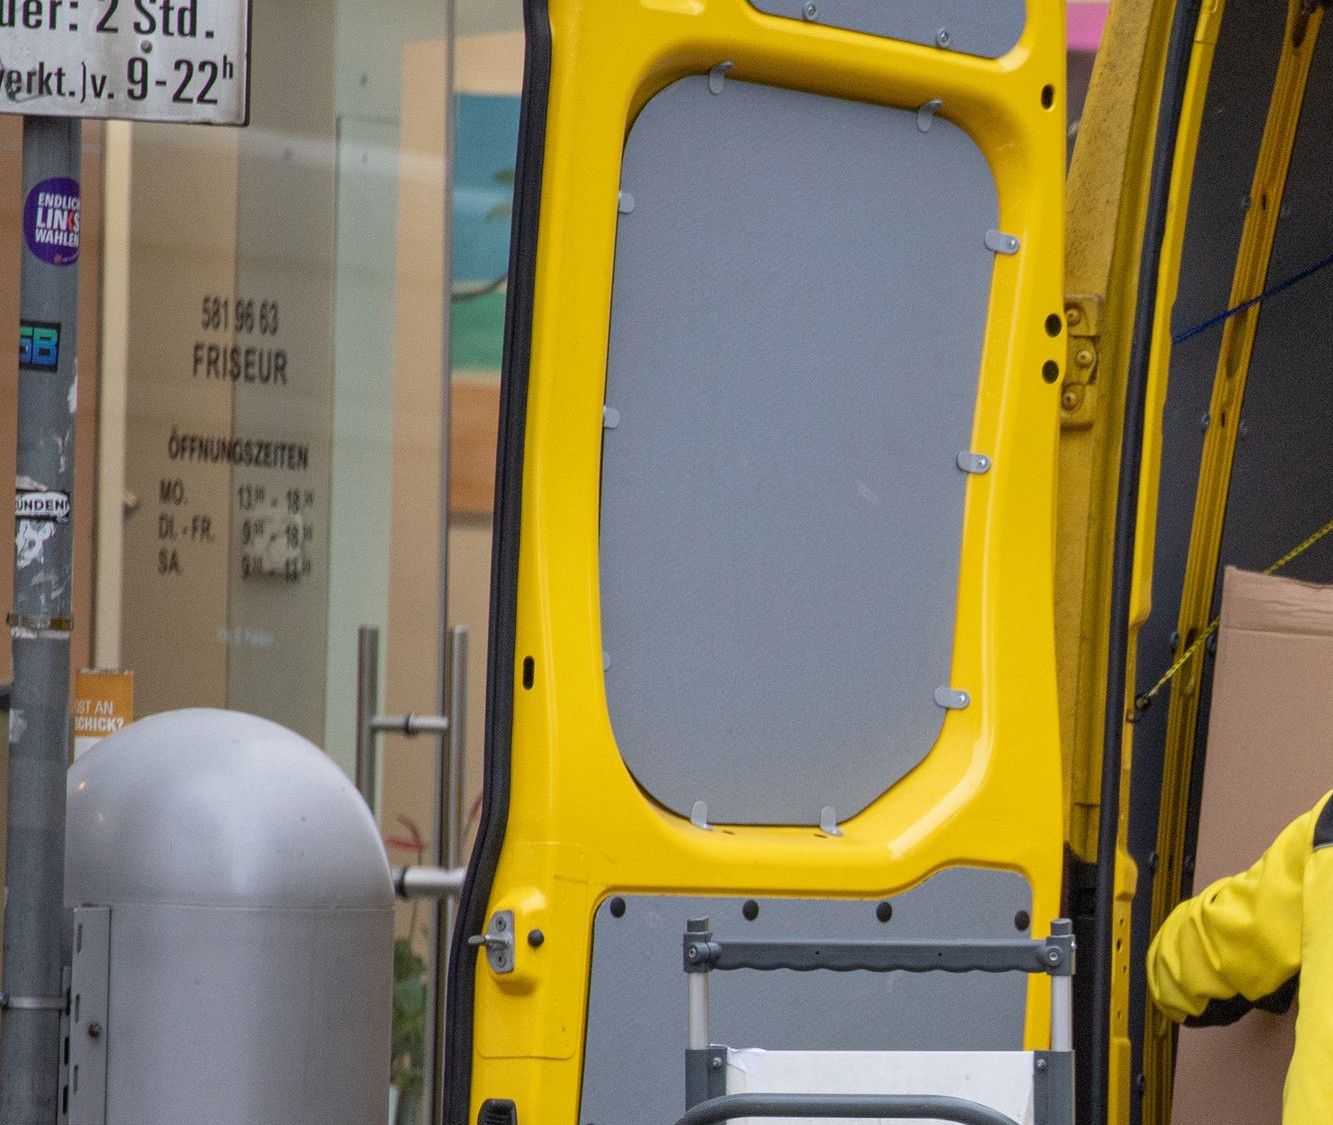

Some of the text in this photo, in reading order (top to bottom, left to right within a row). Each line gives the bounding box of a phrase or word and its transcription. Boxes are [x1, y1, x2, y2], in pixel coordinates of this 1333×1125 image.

[96, 0, 119, 33] 2
[133, 0, 215, 39] Std.
[193, 341, 289, 387] FRISEUR
[167, 427, 310, 471] ÖFFNUNGSZEITEN
